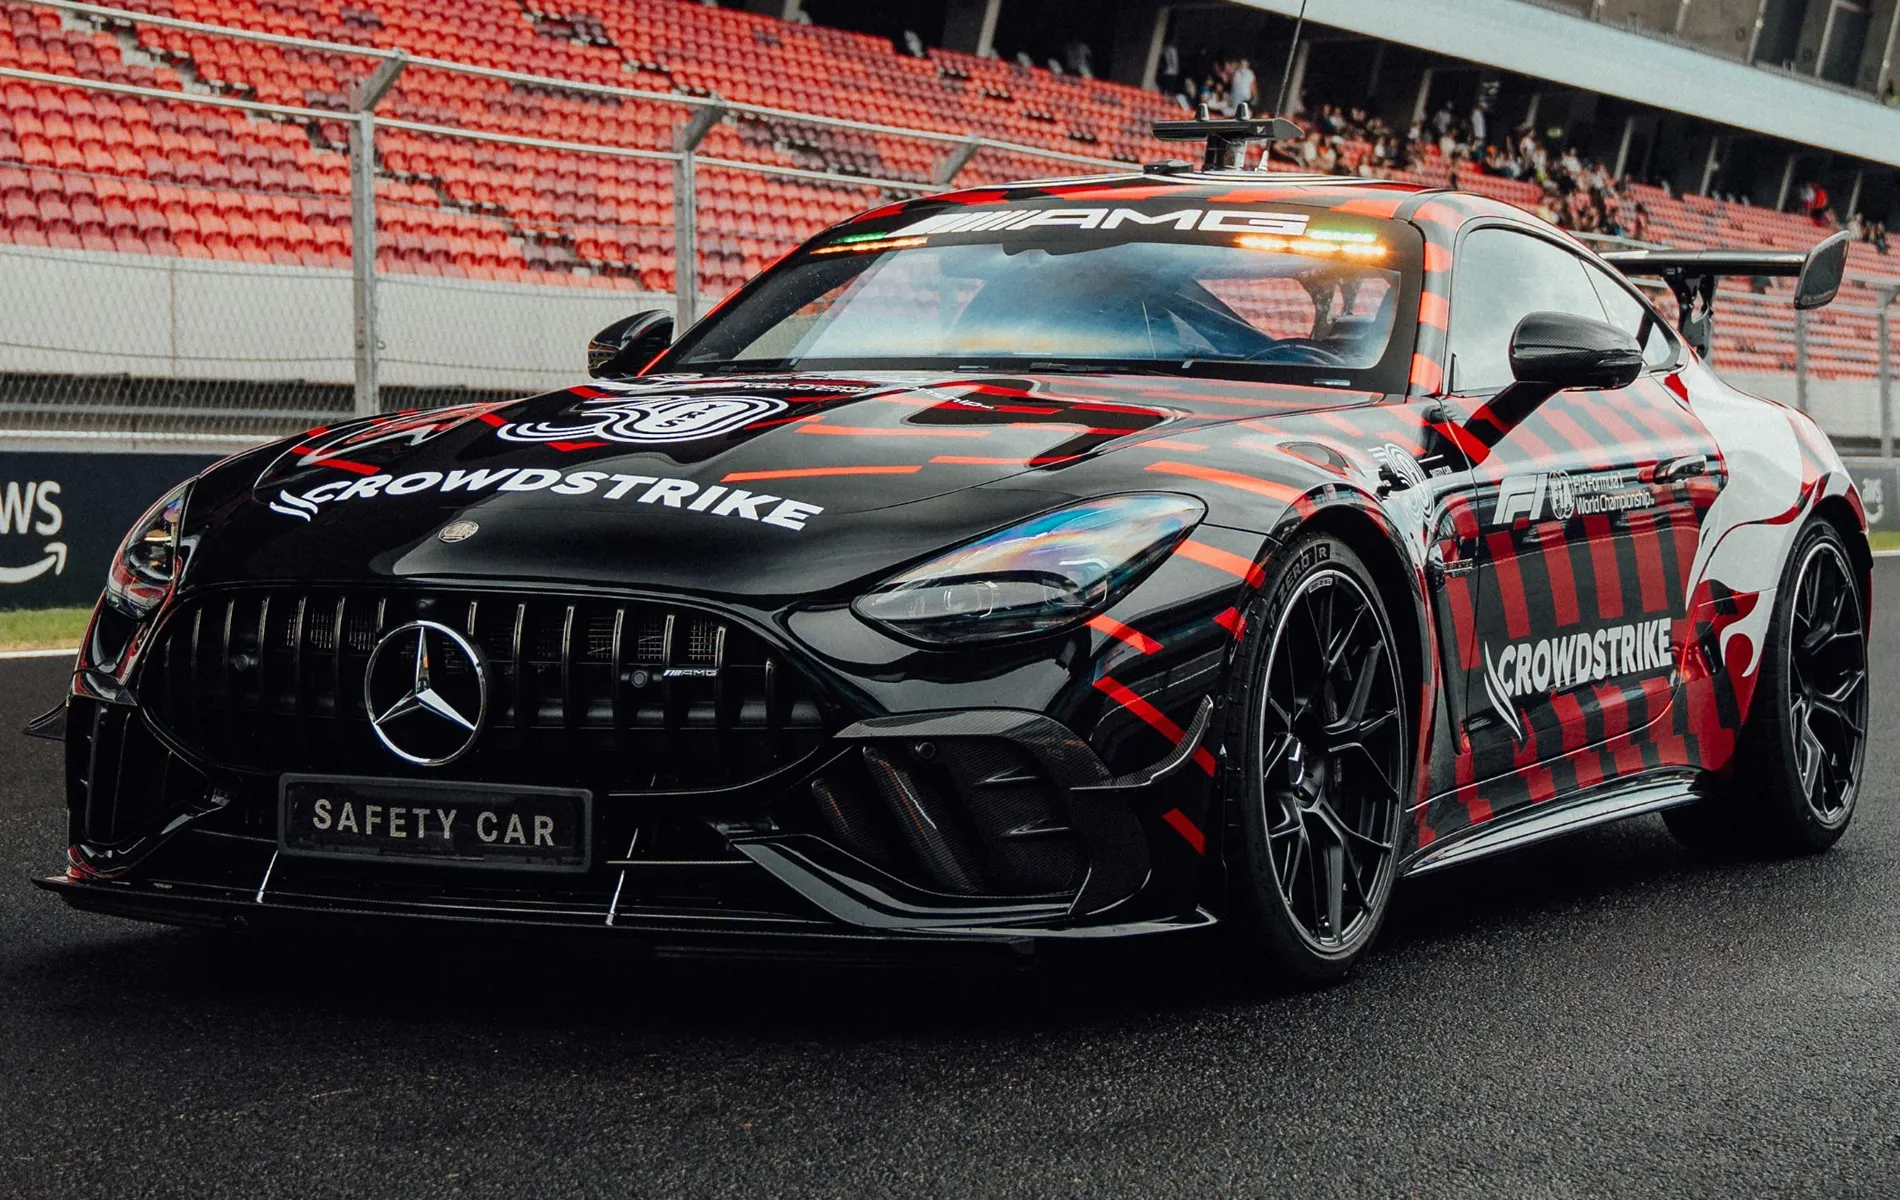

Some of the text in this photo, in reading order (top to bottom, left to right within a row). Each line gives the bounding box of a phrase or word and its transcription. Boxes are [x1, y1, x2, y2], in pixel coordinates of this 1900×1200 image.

[1011, 208, 1310, 236] AMG
[300, 468, 825, 531] CROWDSTRIKE
[1588, 473, 1619, 492] Formula
[1576, 495, 1600, 515] World
[1277, 553, 1311, 603] ZERO
[679, 668, 719, 677] AMG
[1497, 617, 1673, 697] CROWDSTRIKE
[312, 798, 556, 847] SAFETY CAR
